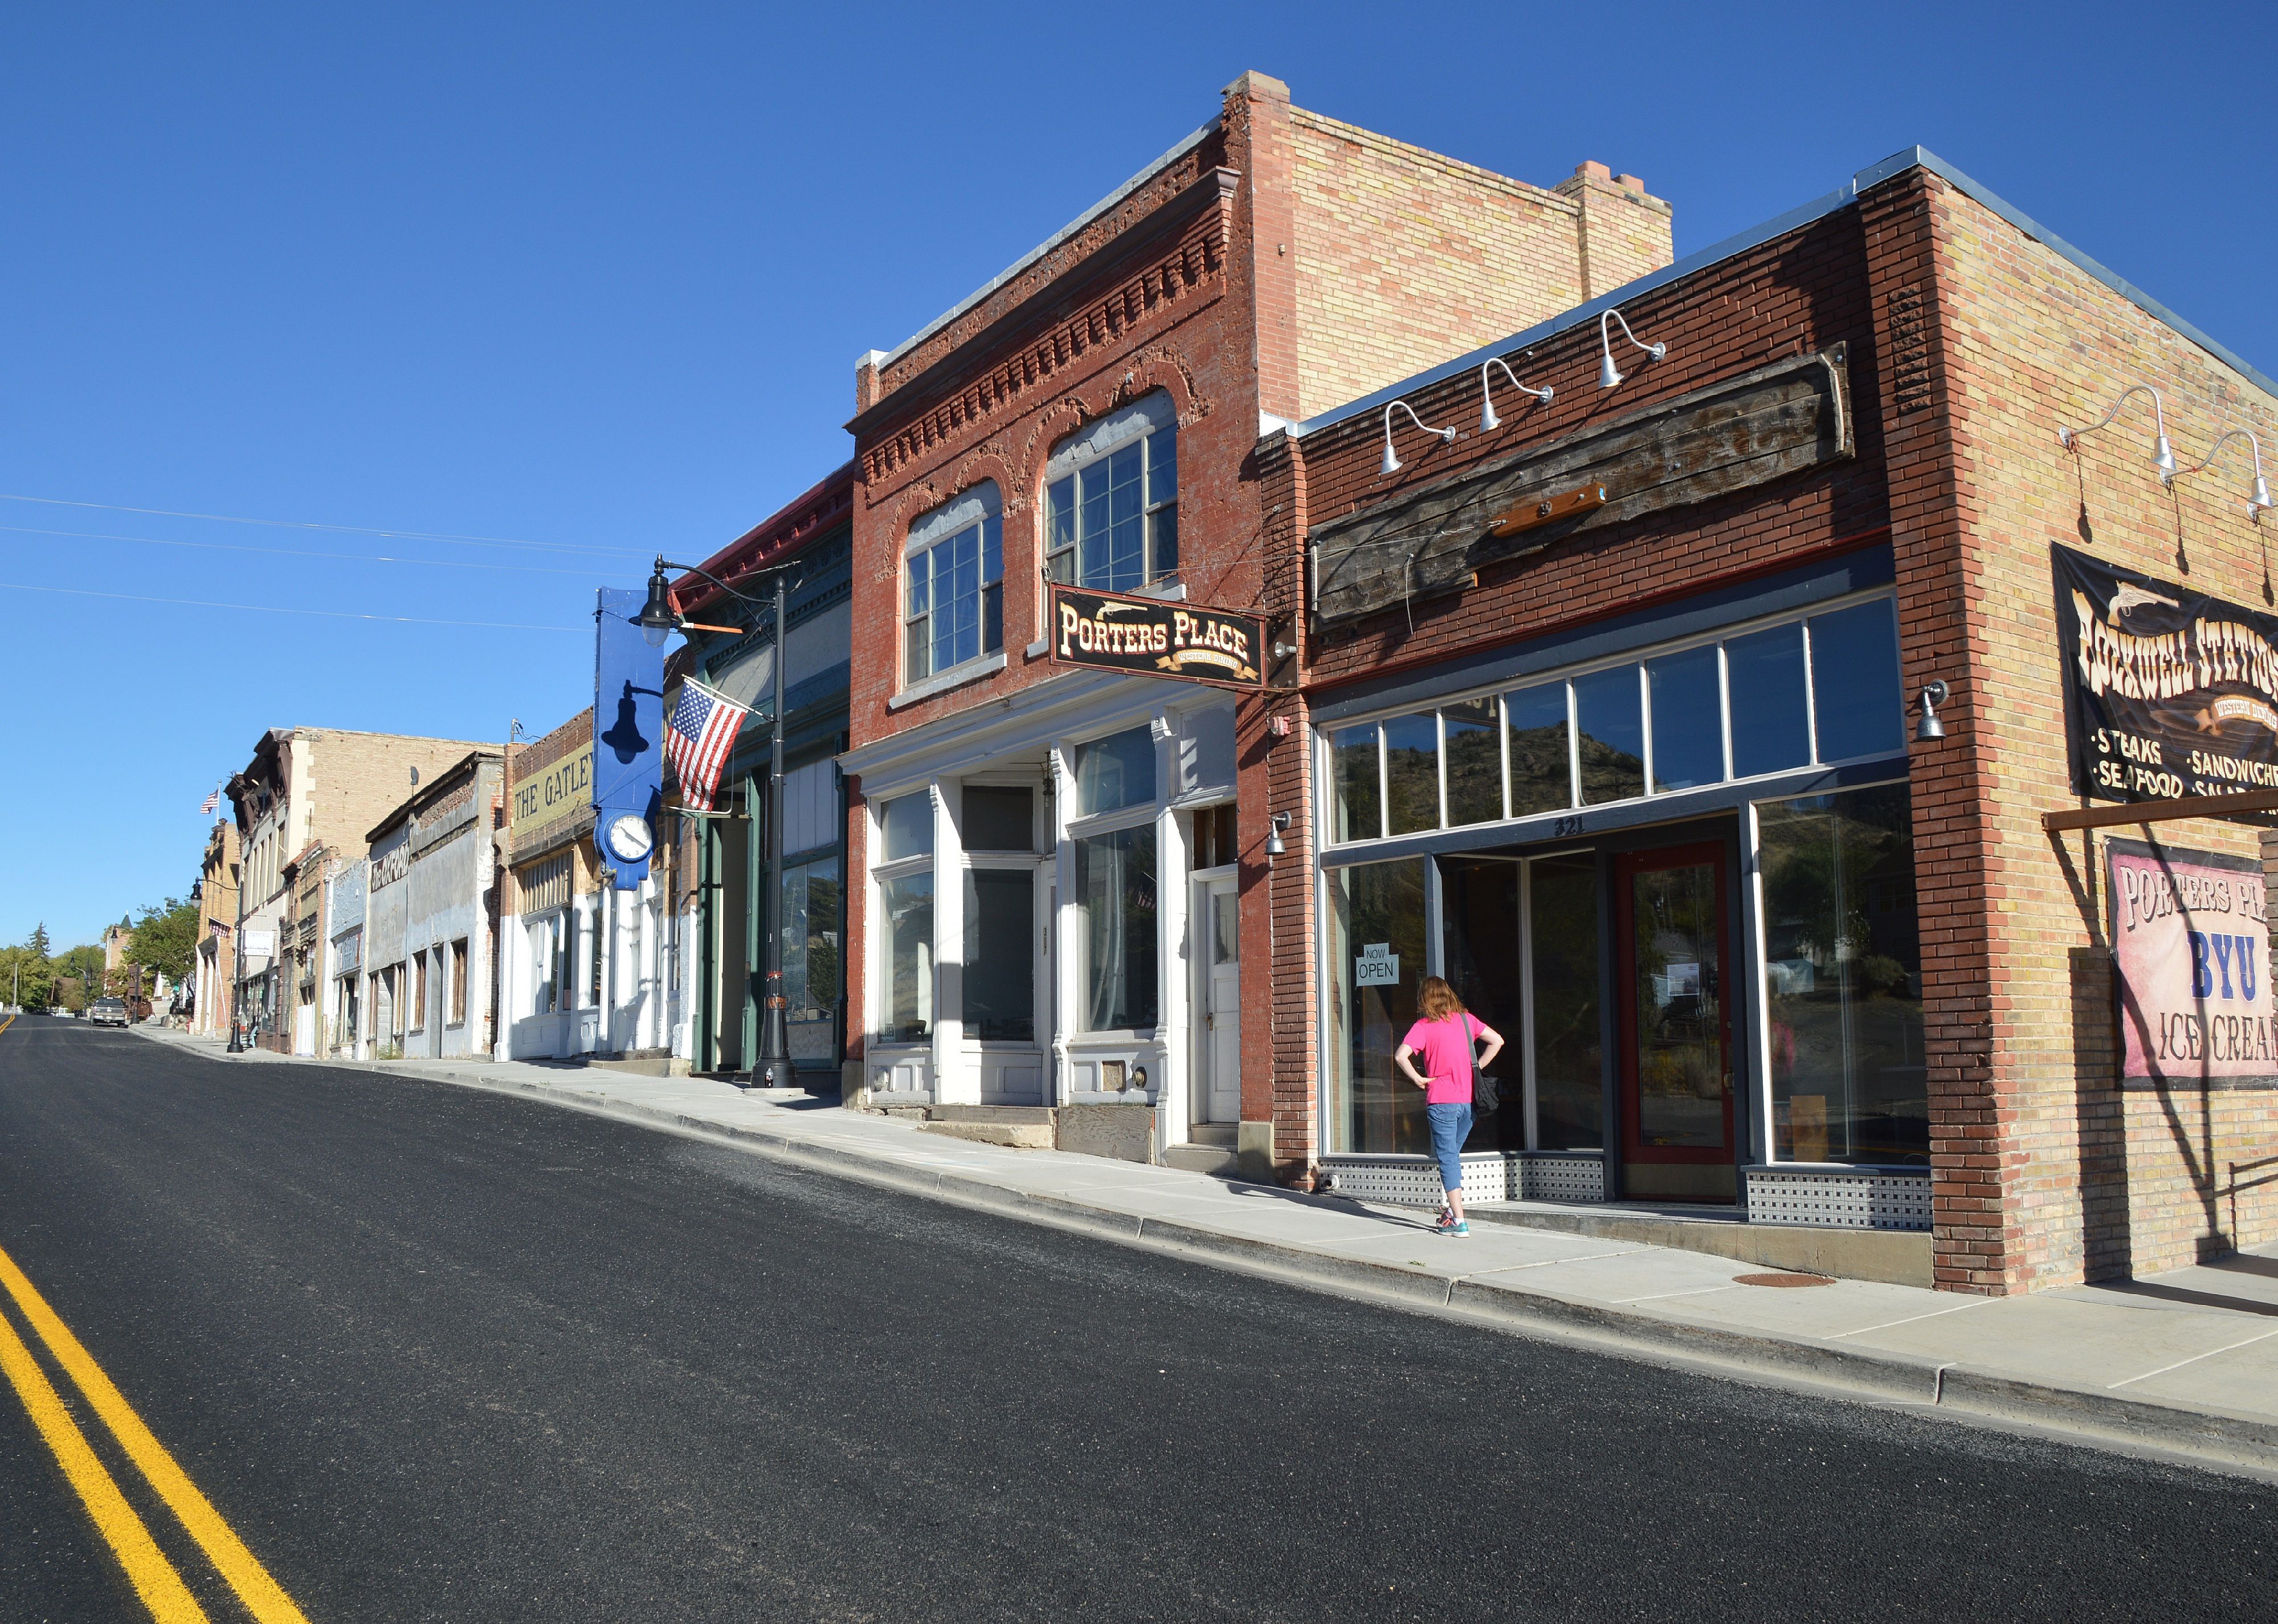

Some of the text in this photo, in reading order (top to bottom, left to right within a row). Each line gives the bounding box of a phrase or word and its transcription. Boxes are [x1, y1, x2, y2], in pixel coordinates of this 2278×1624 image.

[1060, 602, 1249, 661] PORTERS PLACE
[2072, 587, 2194, 701] ROCKWELL
[1178, 652, 1238, 669] WESTERN DINING
[2215, 699, 2251, 718] WESTERN
[2098, 728, 2162, 765] STEAKS
[2099, 760, 2183, 799] SEAFOOD
[515, 784, 537, 821] THE
[1554, 815, 1585, 837] 321
[382, 842, 410, 887] OXFORD
[2120, 866, 2231, 932] PORTERS
[1359, 962, 1393, 978] OPEN
[1367, 949, 1385, 959] NOW
[2186, 930, 2256, 1002] BYU
[2158, 1012, 2203, 1060] ICE
